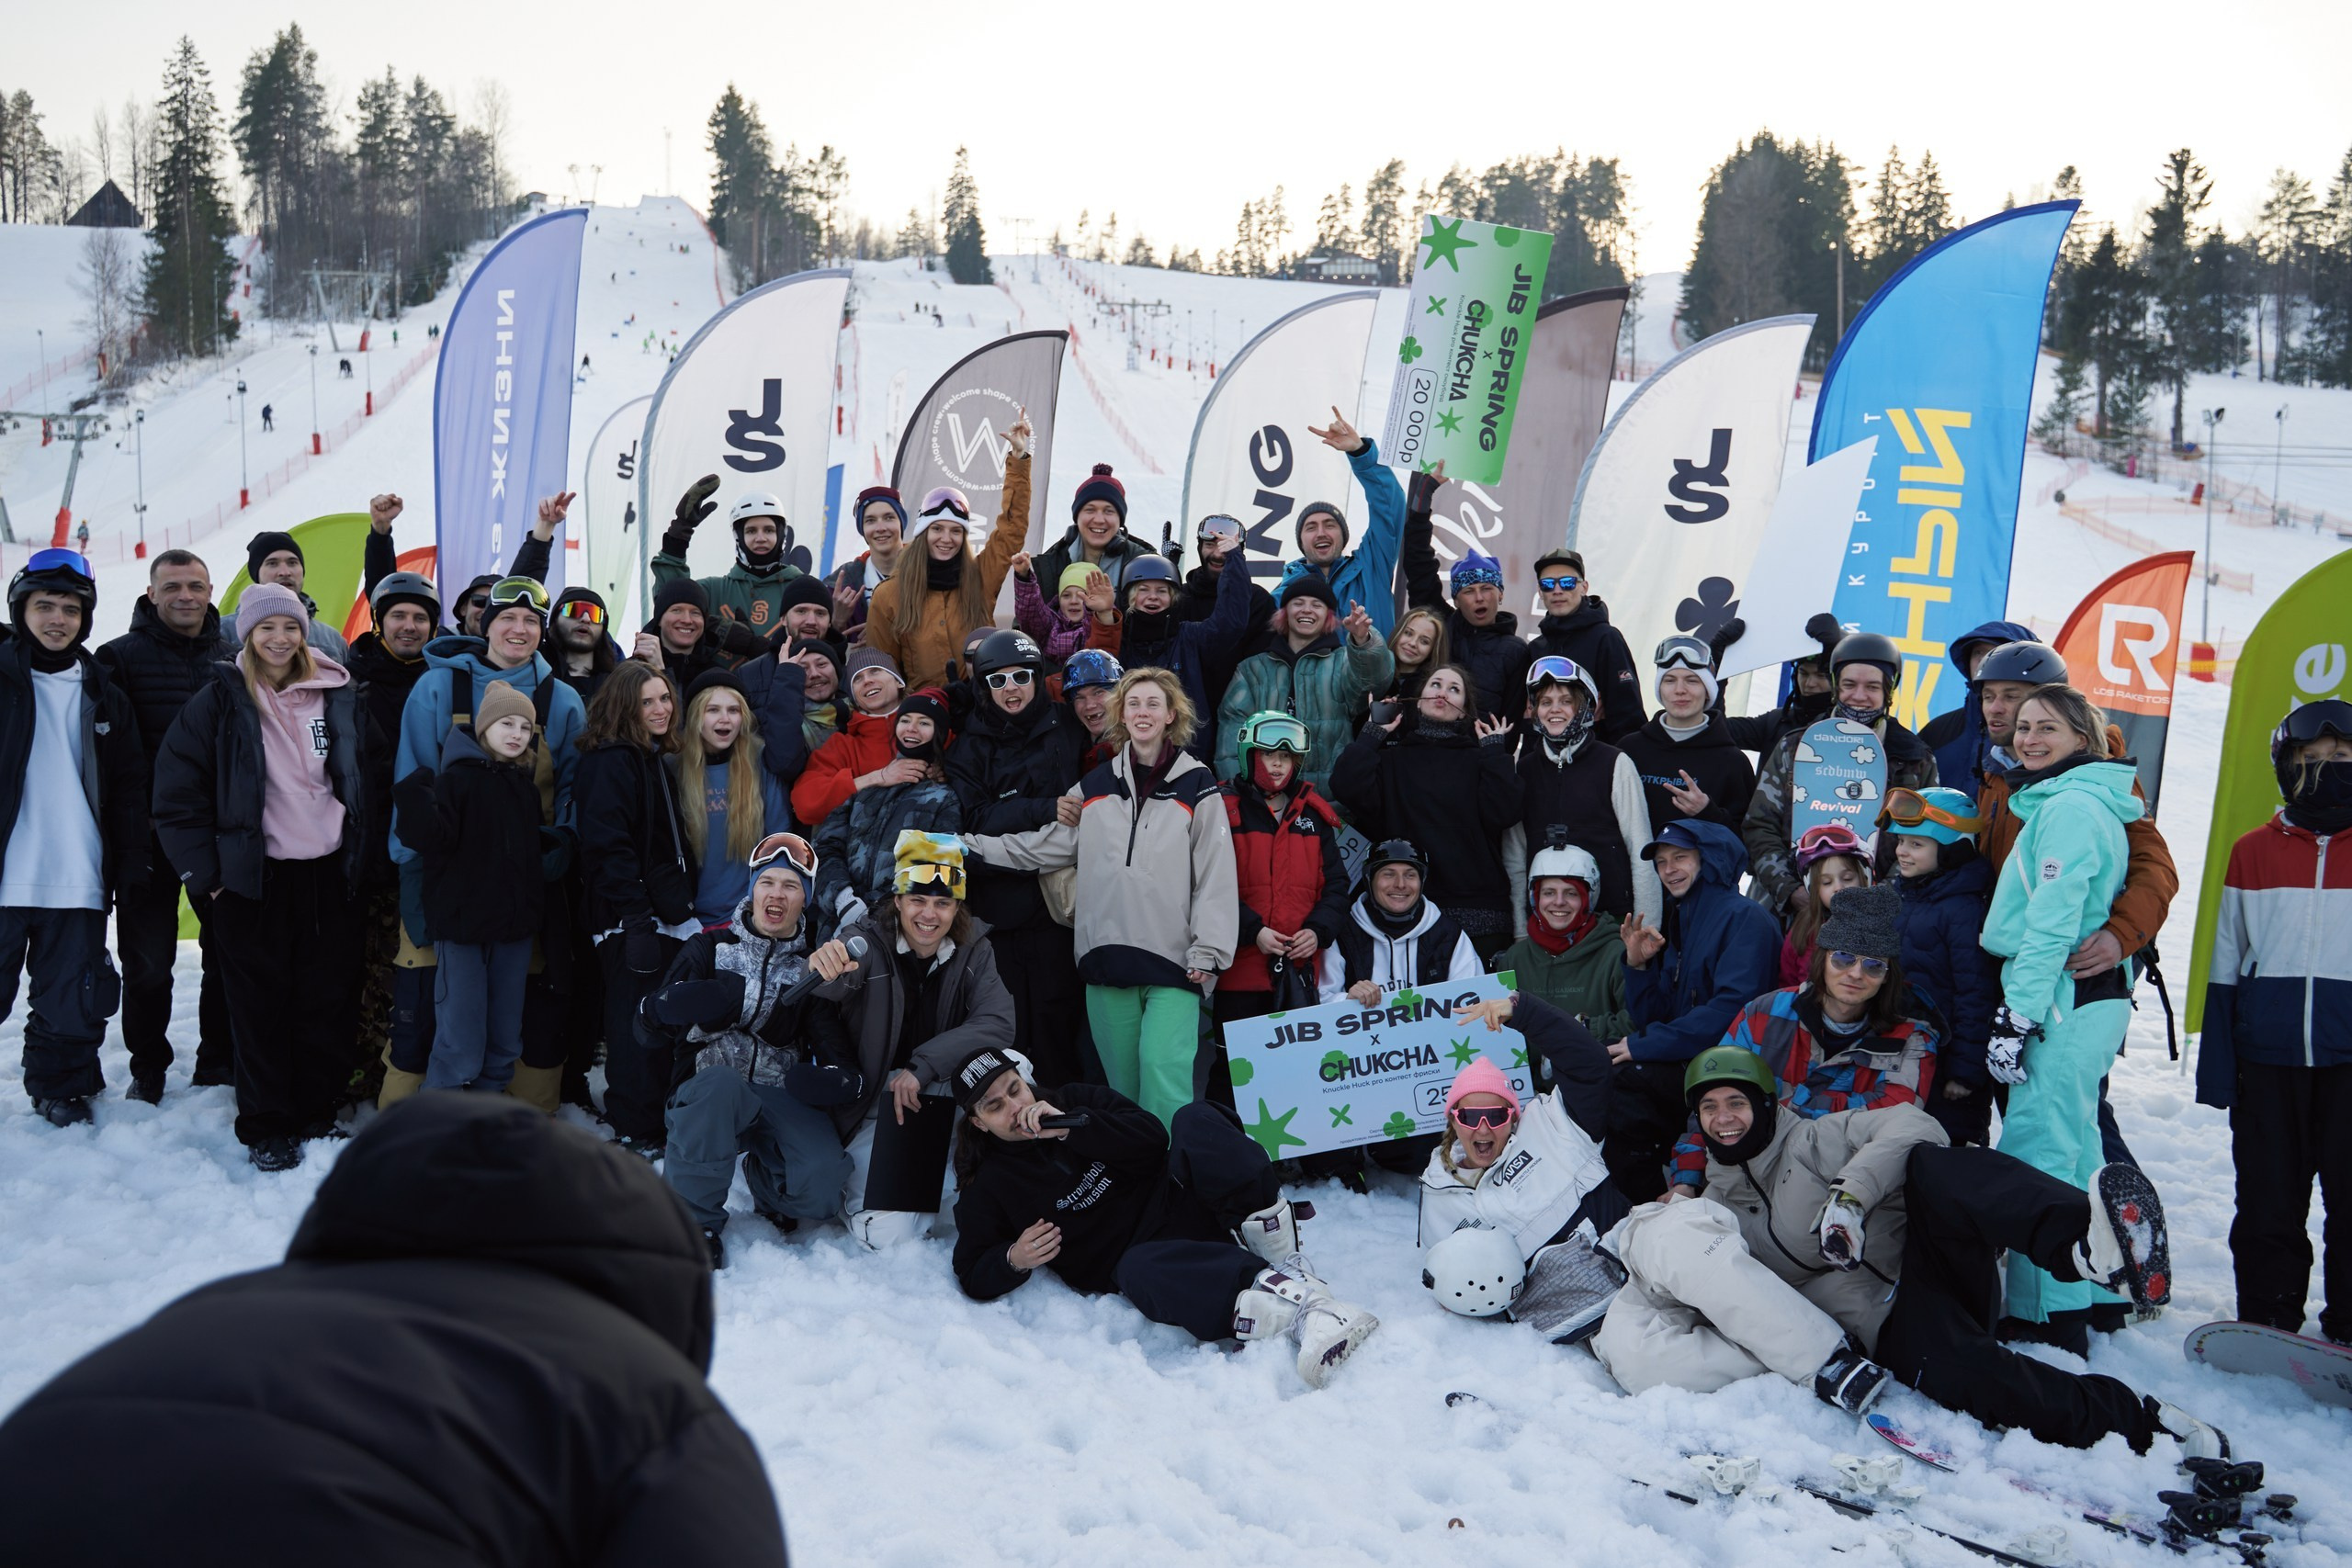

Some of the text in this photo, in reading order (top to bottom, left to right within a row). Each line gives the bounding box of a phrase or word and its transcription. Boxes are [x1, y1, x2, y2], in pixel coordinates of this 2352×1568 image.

[1456, 294, 1465, 319] Knuckle
[1453, 320, 1461, 335] Huck
[1448, 299, 1486, 401] CHUKCHA
[1479, 263, 1532, 452] JIB SPRING
[492, 289, 514, 500] ЖИЗНИ
[943, 388, 980, 412] welcome
[982, 388, 1012, 403] shape
[1413, 378, 1431, 404] 20
[932, 411, 944, 434] crew
[932, 436, 944, 467] shape
[942, 465, 976, 491] welcome
[1246, 424, 1295, 577] ING
[1849, 412, 1881, 585] КУРОТ
[2093, 687, 2170, 705] LOS RAKETOS
[1810, 800, 1862, 814] Revival
[1264, 991, 1480, 1049] JIB SPRING
[1319, 1043, 1440, 1082] CHUKCHA
[1322, 1068, 1441, 1094] Knuckle Huck pro контест фриски
[1505, 1155, 1529, 1179] NASA
[1057, 1161, 1105, 1211] Stronghold
[1073, 1178, 1112, 1211] Division
[1704, 1244, 1716, 1256] THE
